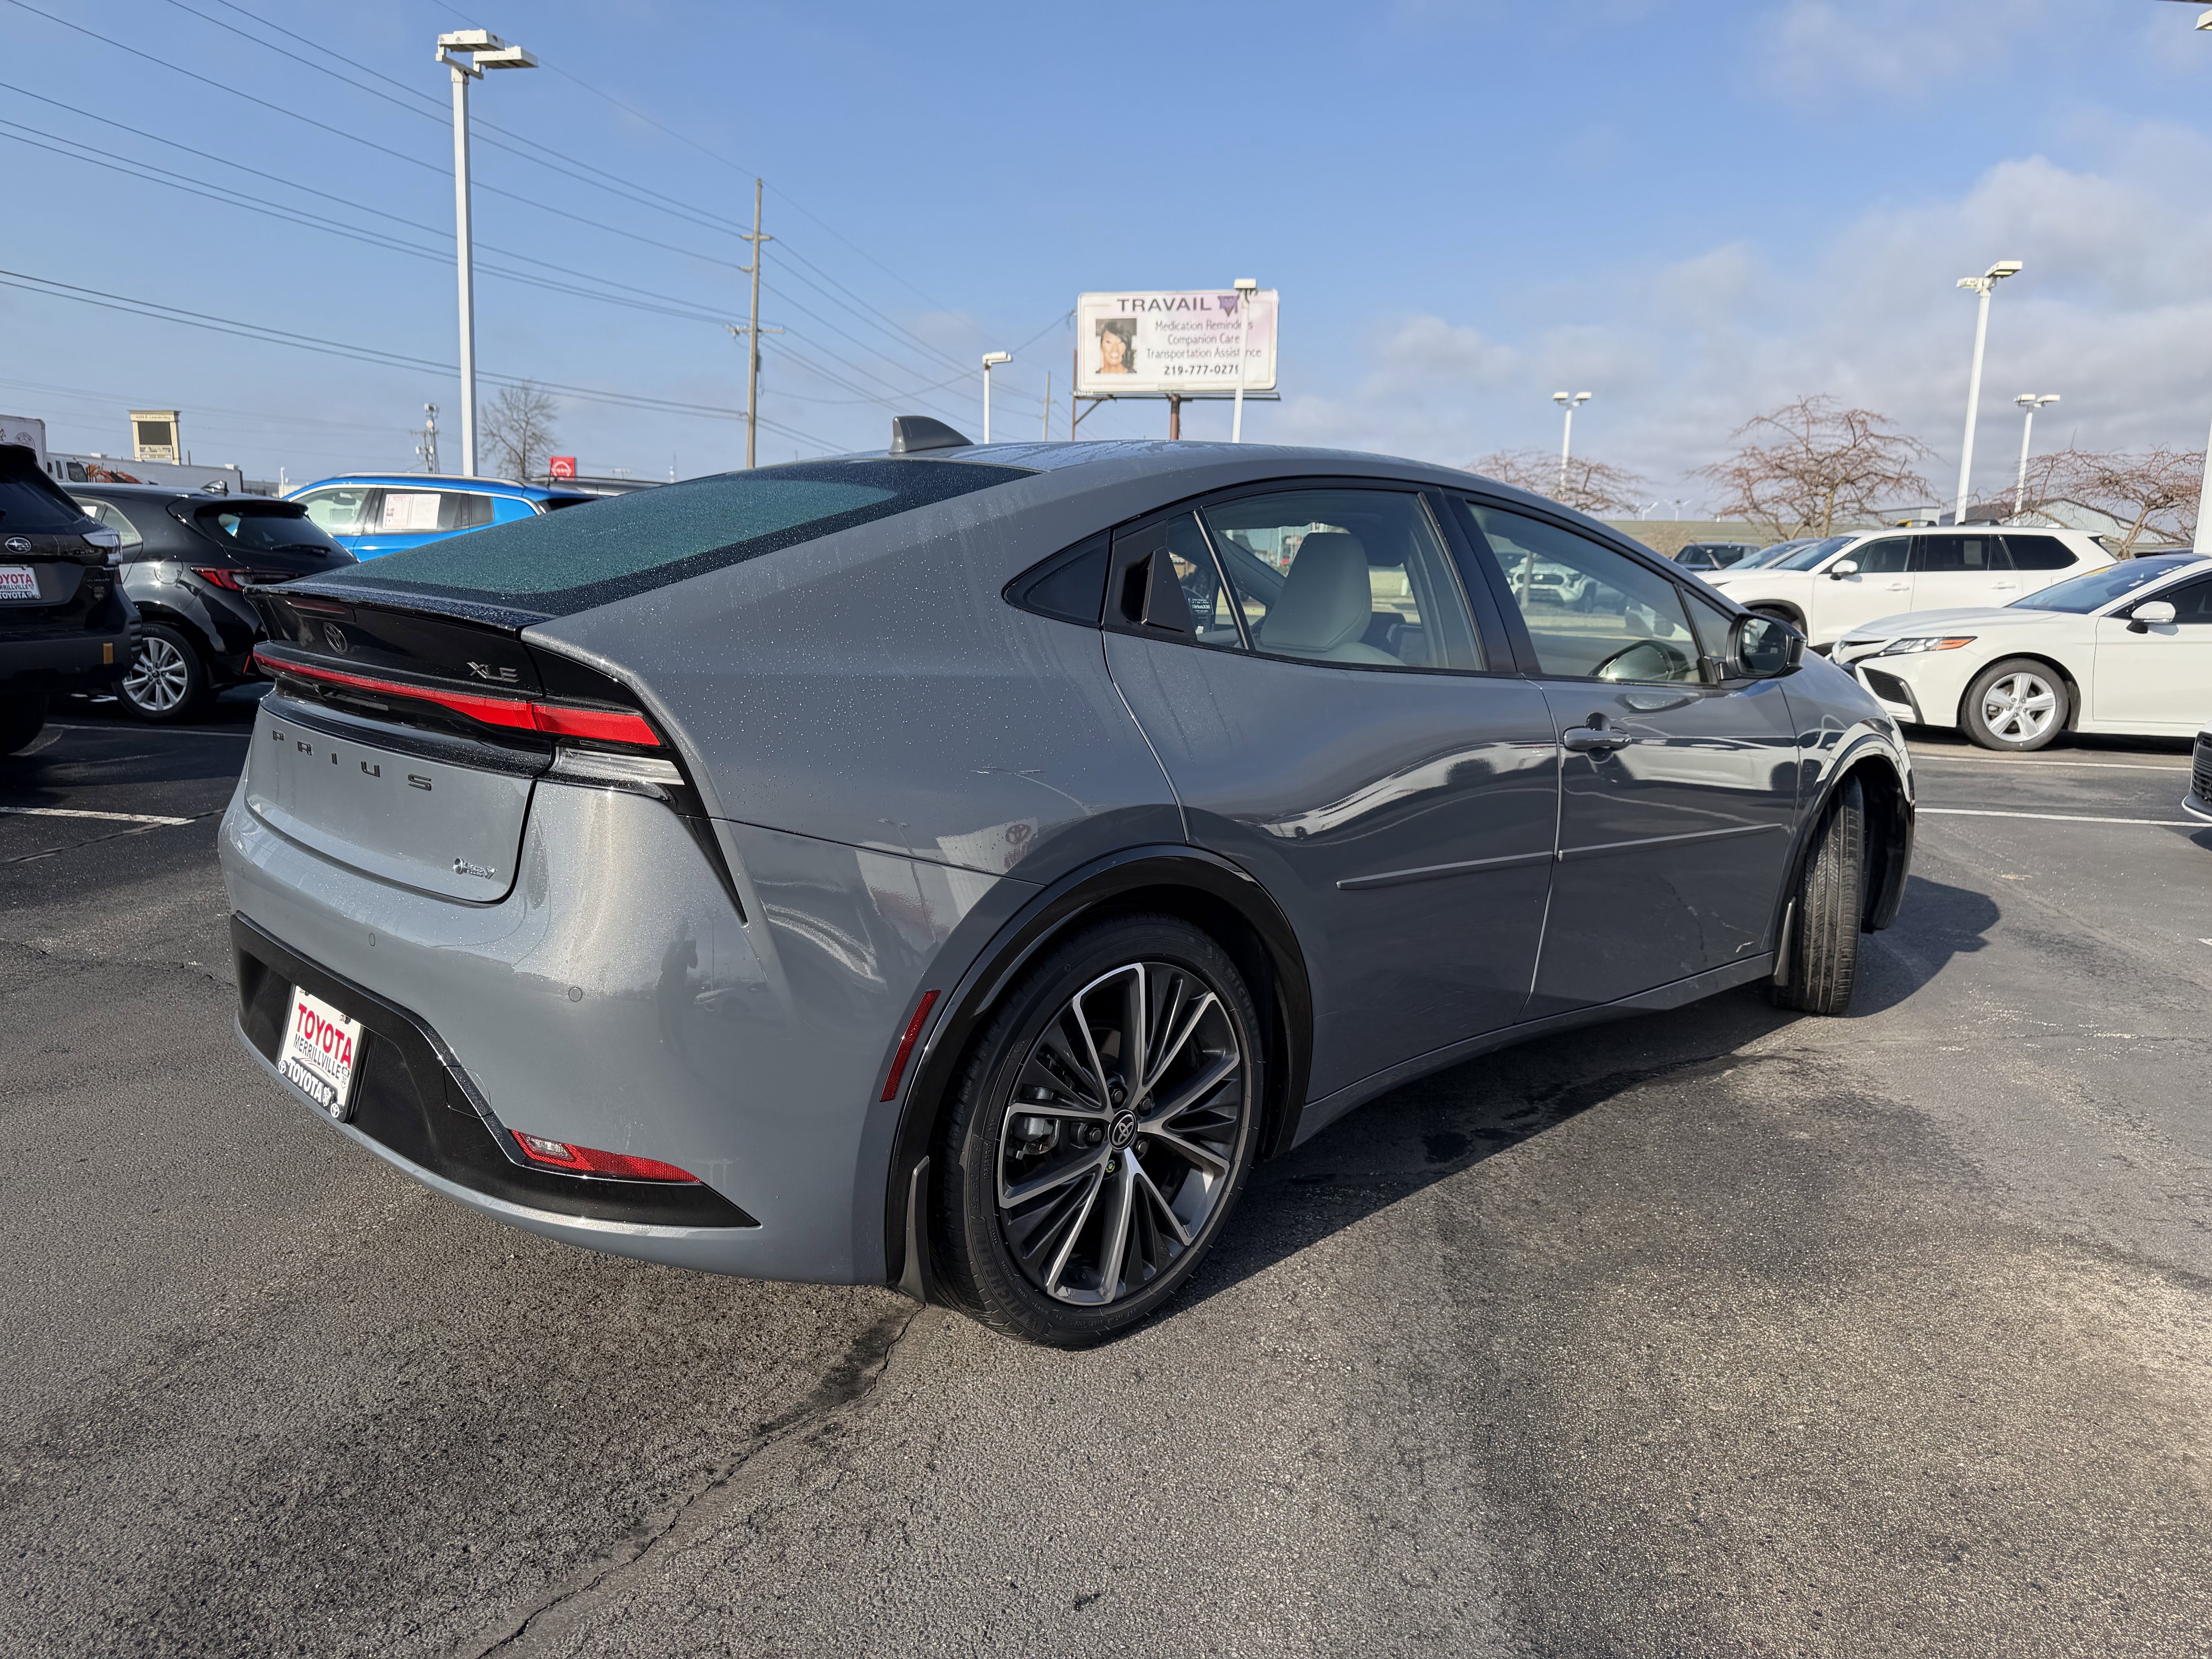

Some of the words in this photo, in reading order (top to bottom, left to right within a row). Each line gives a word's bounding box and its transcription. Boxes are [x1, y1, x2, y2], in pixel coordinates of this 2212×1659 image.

[1117, 297, 1211, 312] TRAVAIL
[1155, 320, 1202, 331] Medication
[1206, 319, 1253, 330] Reminds
[1167, 334, 1217, 346] Companion
[1219, 332, 1240, 344] Care
[1147, 348, 1212, 361] Transportation
[1214, 348, 1262, 359] Assistnce
[467, 661, 519, 683] XLE
[273, 730, 431, 791] PRIUS
[464, 862, 496, 879] HEV
[297, 1003, 352, 1069] TOYOTA
[293, 1034, 341, 1079] MERRILLVILLE
[288, 1062, 323, 1103] TOYOTA
[974, 1231, 1027, 1318] MICHELIN
